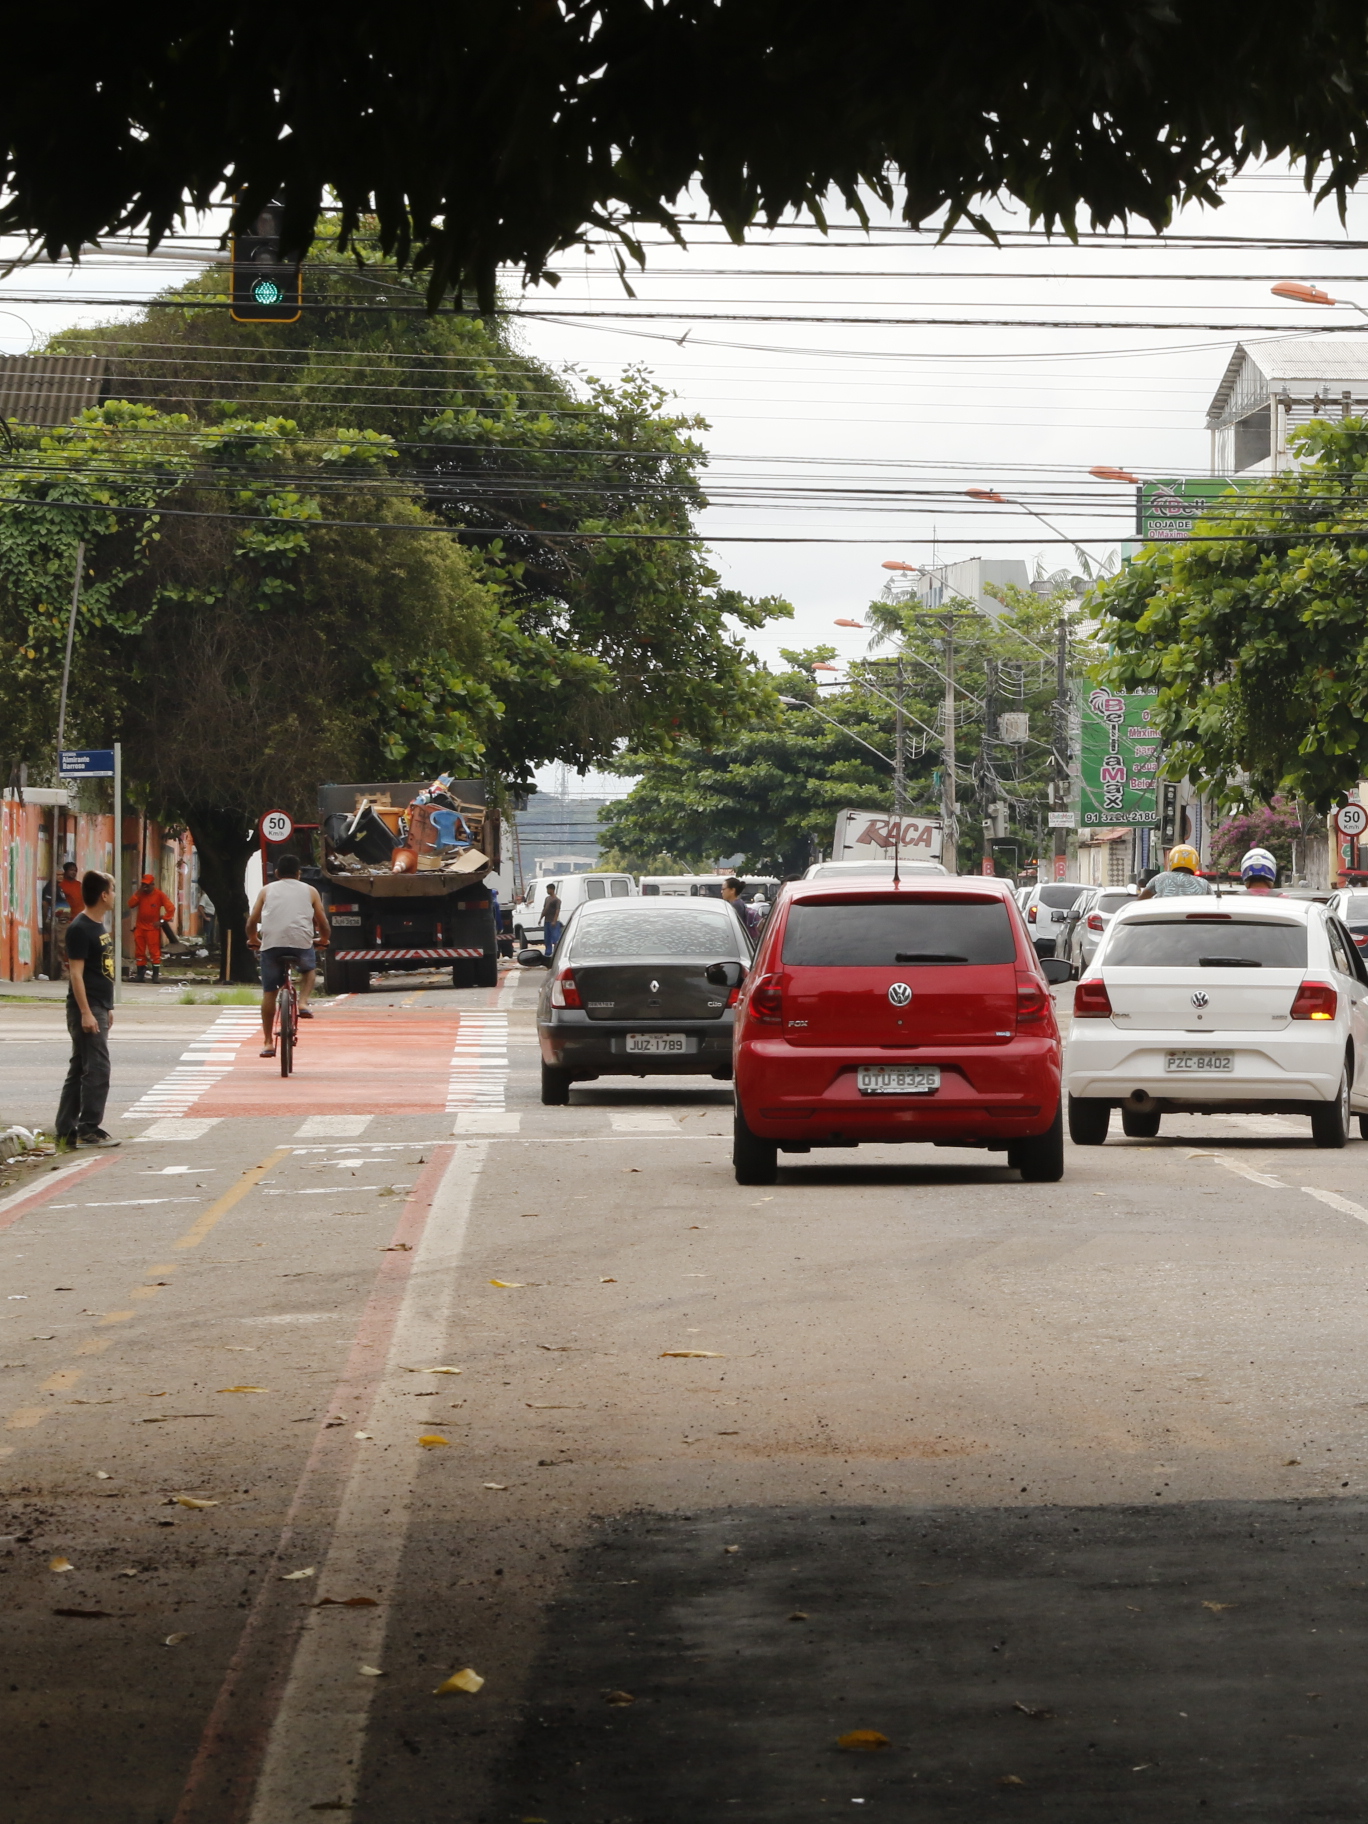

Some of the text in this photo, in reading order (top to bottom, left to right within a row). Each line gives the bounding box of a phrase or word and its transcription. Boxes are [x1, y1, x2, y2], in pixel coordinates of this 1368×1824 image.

[1148, 520, 1192, 529] LOJA DE
[62, 762, 86, 770] Barroso
[1086, 813, 1098, 822] 91
[1343, 811, 1361, 823] 50
[269, 817, 286, 830] 50
[855, 819, 933, 849] RAÇA
